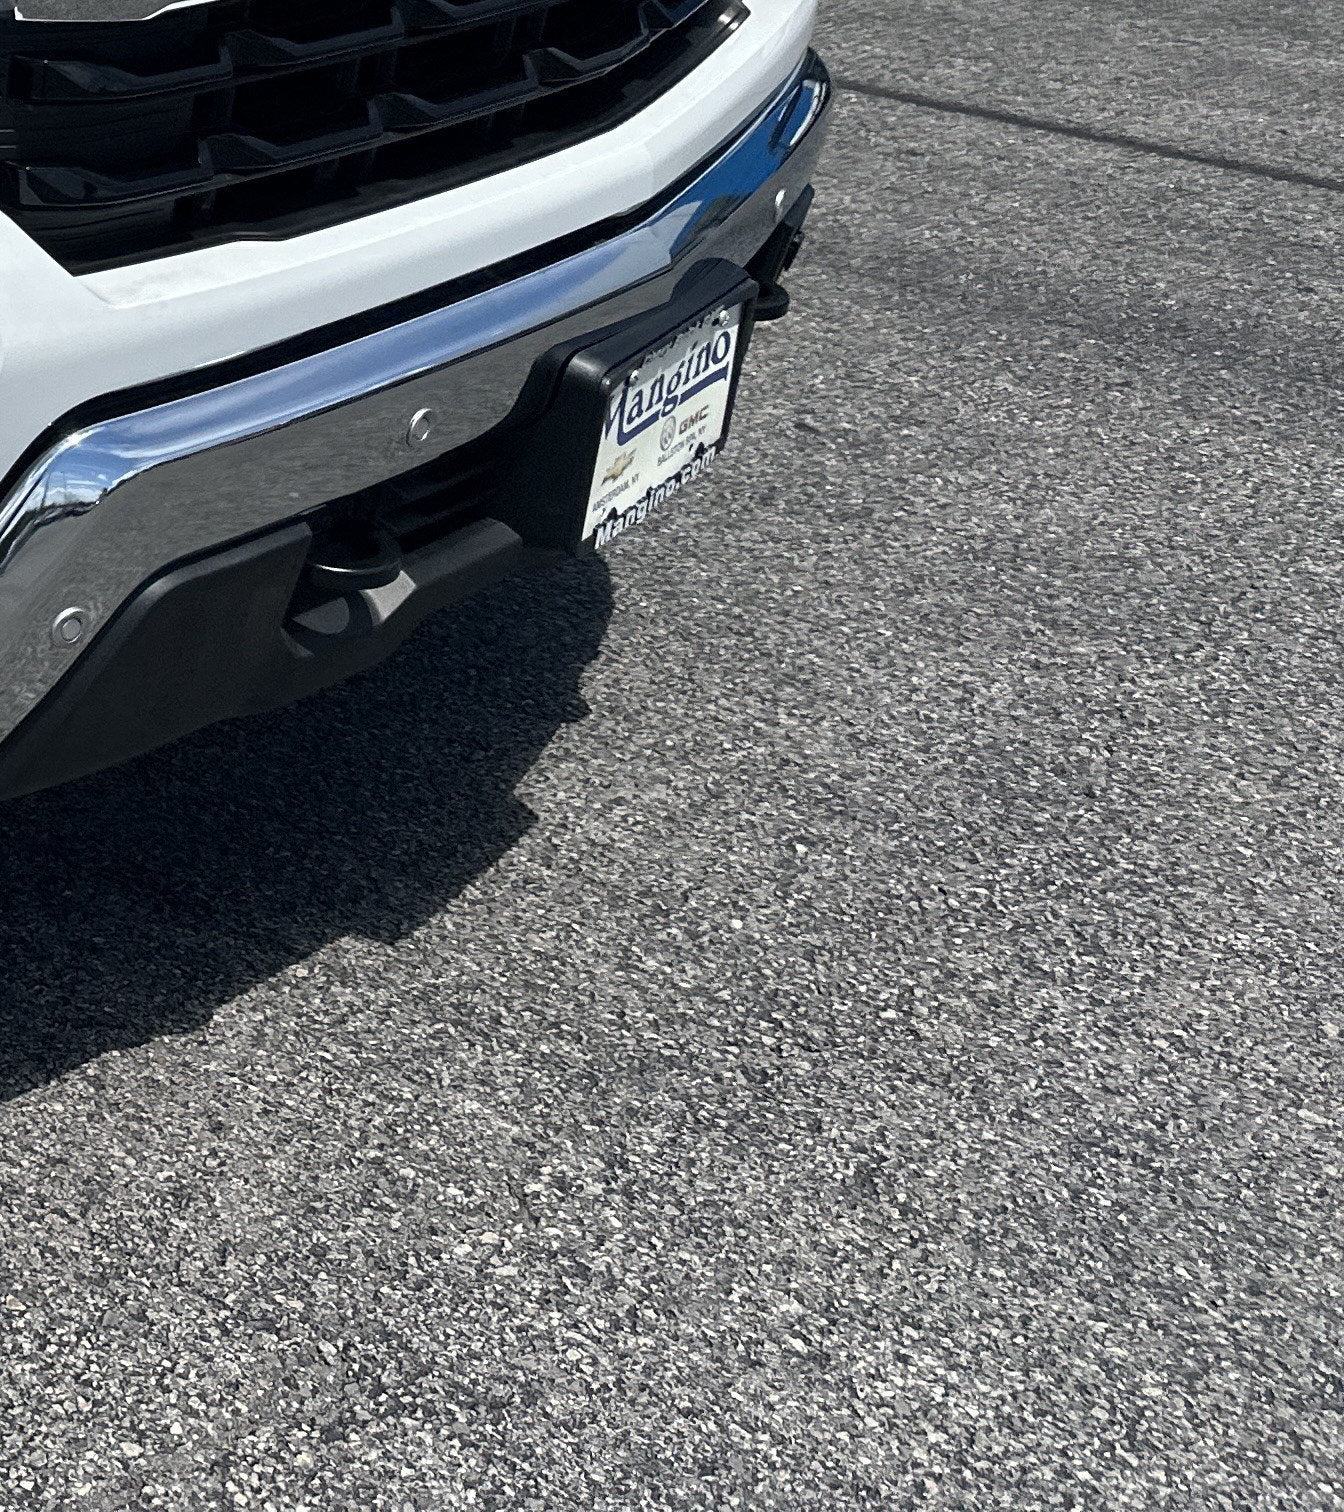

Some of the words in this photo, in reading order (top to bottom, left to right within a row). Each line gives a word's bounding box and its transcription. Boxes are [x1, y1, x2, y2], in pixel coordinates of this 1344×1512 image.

[604, 331, 731, 446] Mangino
[679, 405, 709, 435] GMC
[594, 445, 717, 550] Mangino.com
